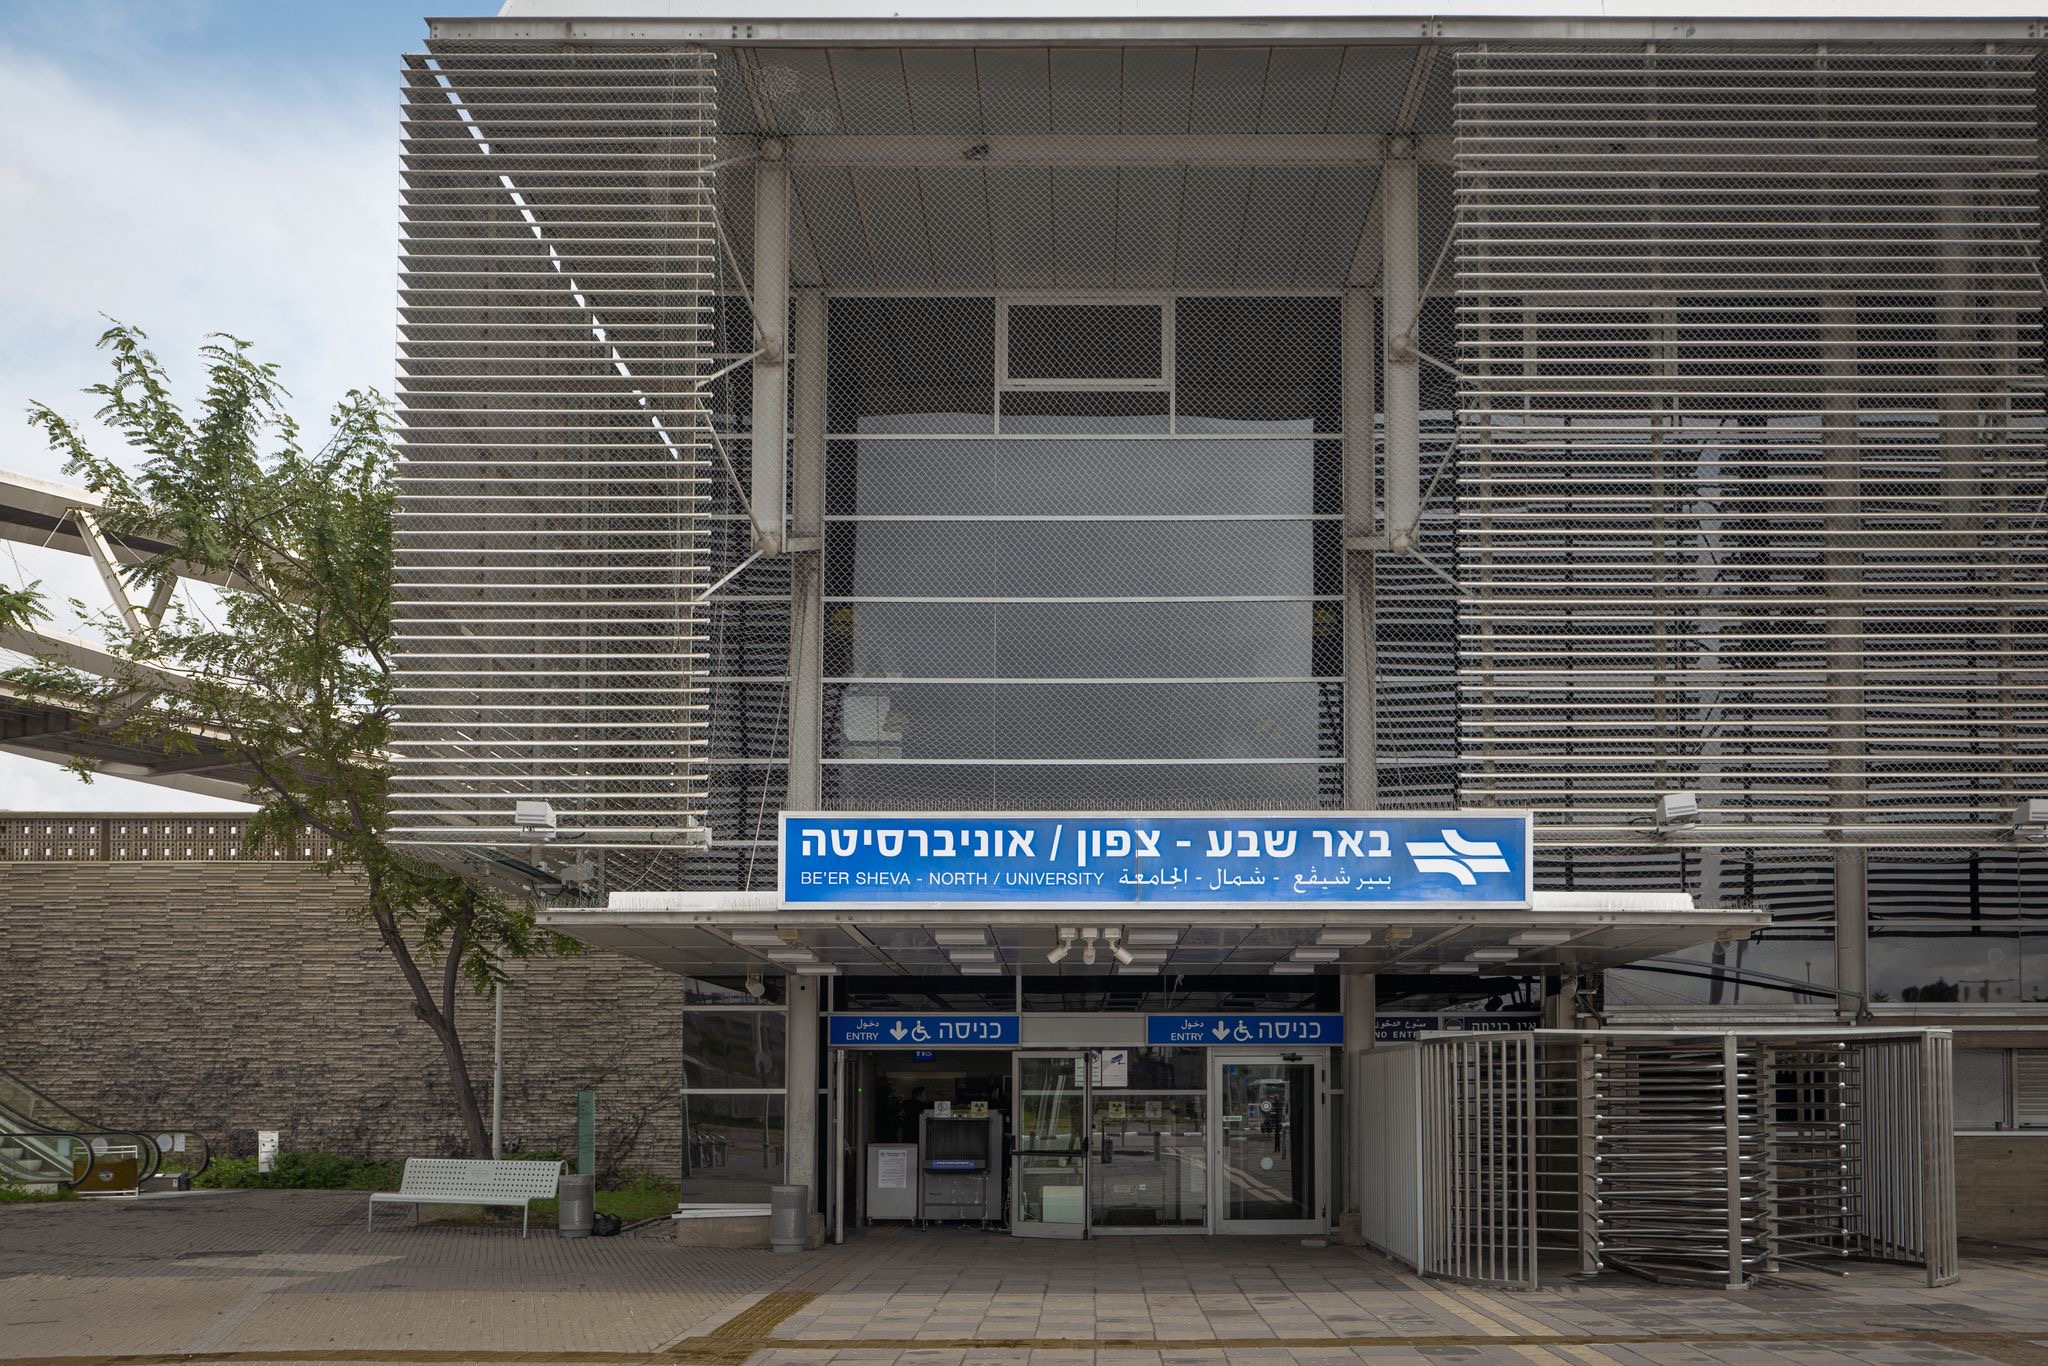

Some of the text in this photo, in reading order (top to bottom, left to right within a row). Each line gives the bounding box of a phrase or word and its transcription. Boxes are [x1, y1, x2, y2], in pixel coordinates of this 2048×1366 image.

[801, 829, 1036, 858] אוניברסיטה
[1049, 824, 1063, 862] /
[1077, 830, 1161, 867] צפון
[1206, 830, 1298, 858] שבע
[1312, 830, 1392, 858] באר
[800, 871, 850, 886] BE'ER
[855, 871, 911, 886] SHEVA
[929, 871, 988, 886] NORTH
[992, 871, 1001, 886] /
[1005, 871, 1105, 886] UNIVERSITY
[1118, 867, 1188, 890] الجامعة
[1209, 866, 1266, 891] شمال
[856, 1018, 880, 1030] دخول
[939, 1022, 1002, 1039] כניסה
[1181, 1019, 1205, 1030] دخول
[1258, 1022, 1321, 1039] כניסה
[845, 1032, 880, 1041] ENTRY
[1170, 1032, 1204, 1041] ENTRY
